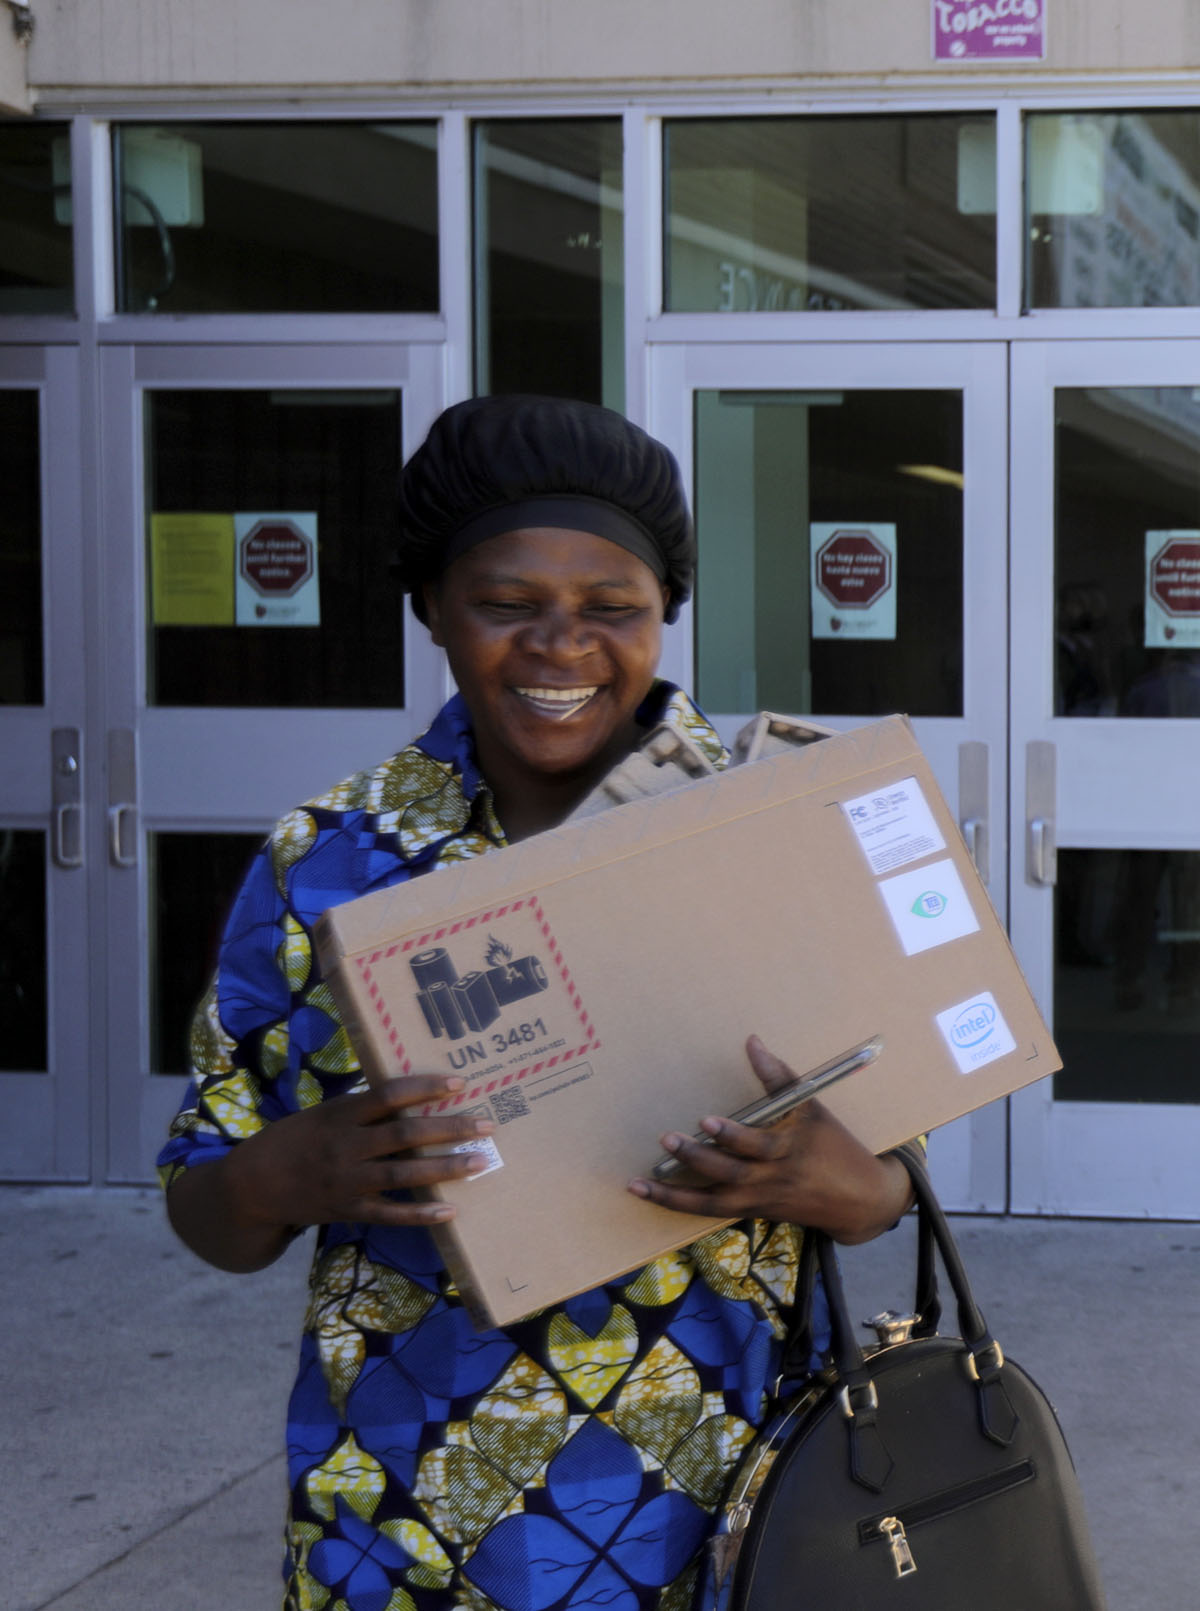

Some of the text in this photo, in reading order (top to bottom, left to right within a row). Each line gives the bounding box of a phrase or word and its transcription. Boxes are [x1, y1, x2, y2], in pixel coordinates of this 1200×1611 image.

[447, 1040, 489, 1070] UN
[491, 1017, 549, 1054] 3481
[953, 1008, 992, 1039] intel
